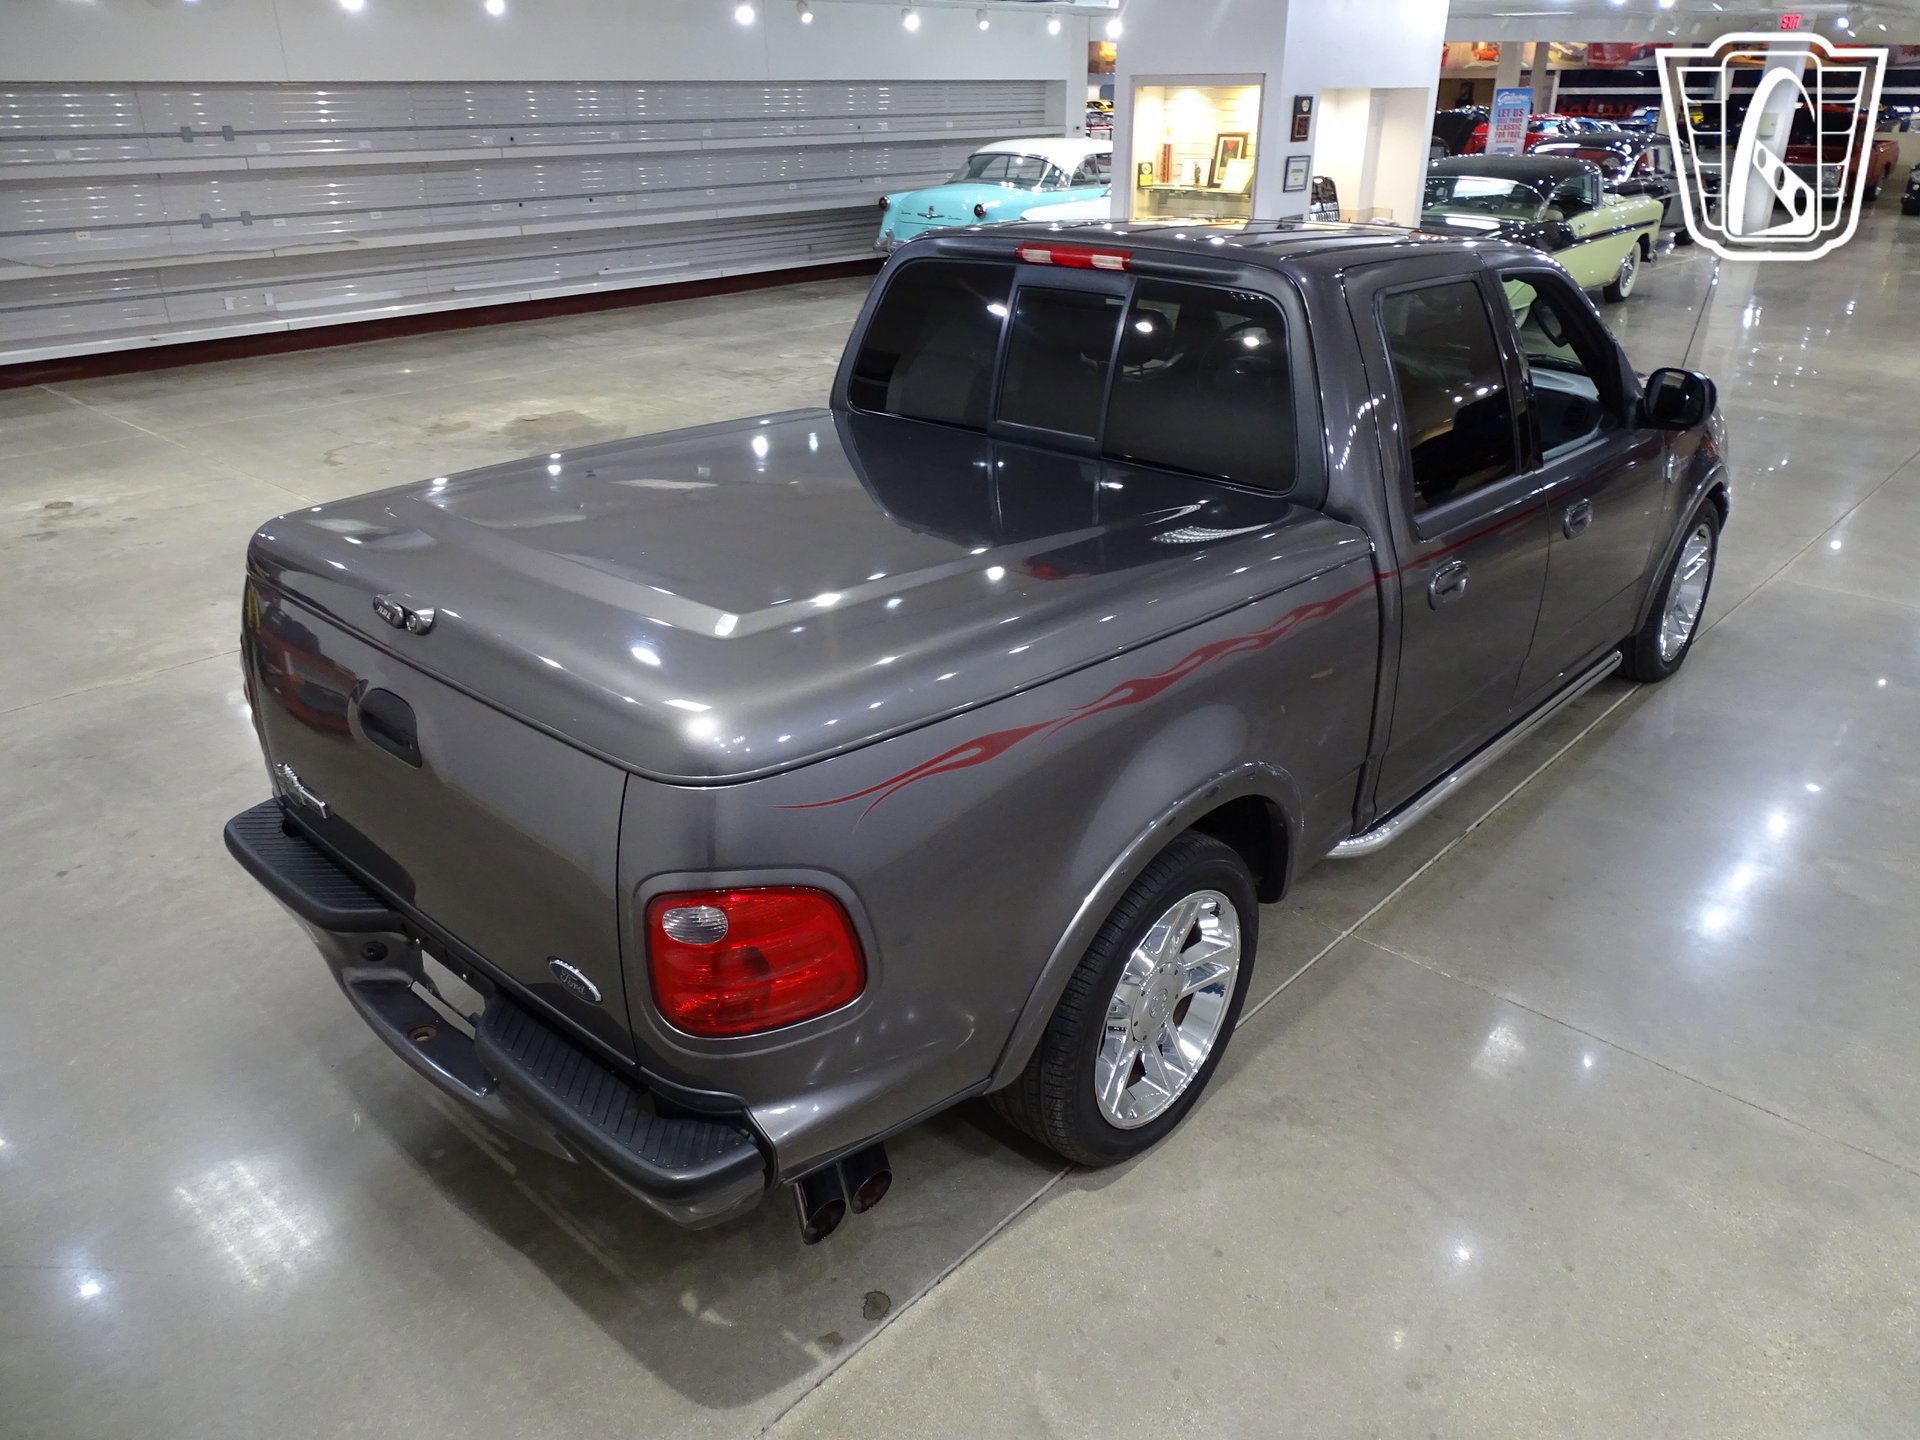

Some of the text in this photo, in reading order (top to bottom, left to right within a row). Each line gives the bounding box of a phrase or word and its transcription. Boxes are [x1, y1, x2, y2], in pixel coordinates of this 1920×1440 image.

[1497, 108, 1524, 117] LET US
[560, 969, 586, 995] Ford
